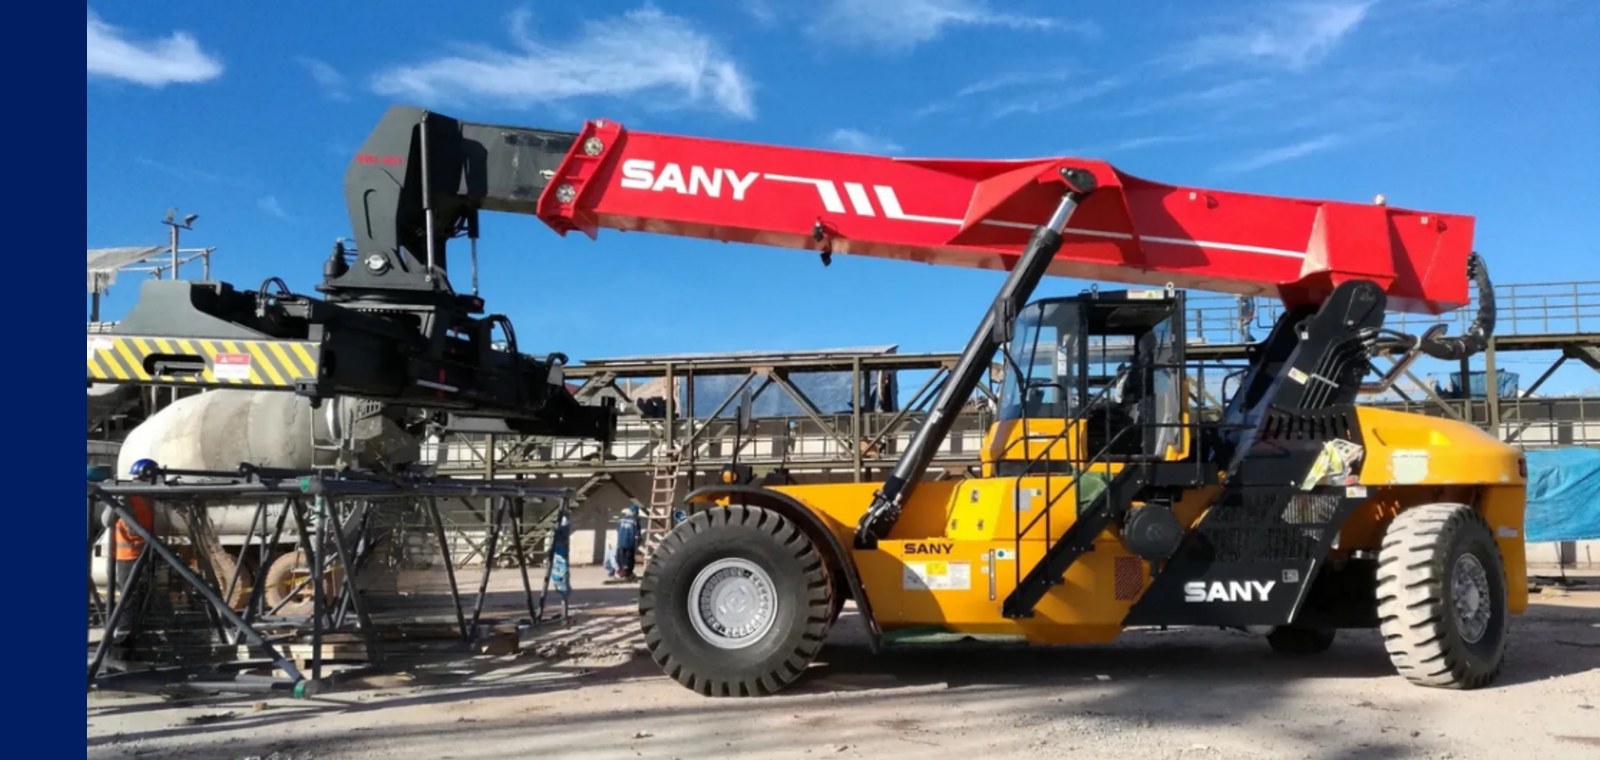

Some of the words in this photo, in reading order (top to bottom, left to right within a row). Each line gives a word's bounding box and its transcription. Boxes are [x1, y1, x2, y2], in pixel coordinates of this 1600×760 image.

[621, 159, 760, 201] SANY
[904, 543, 954, 554] SANY
[1184, 580, 1276, 602] SANY
